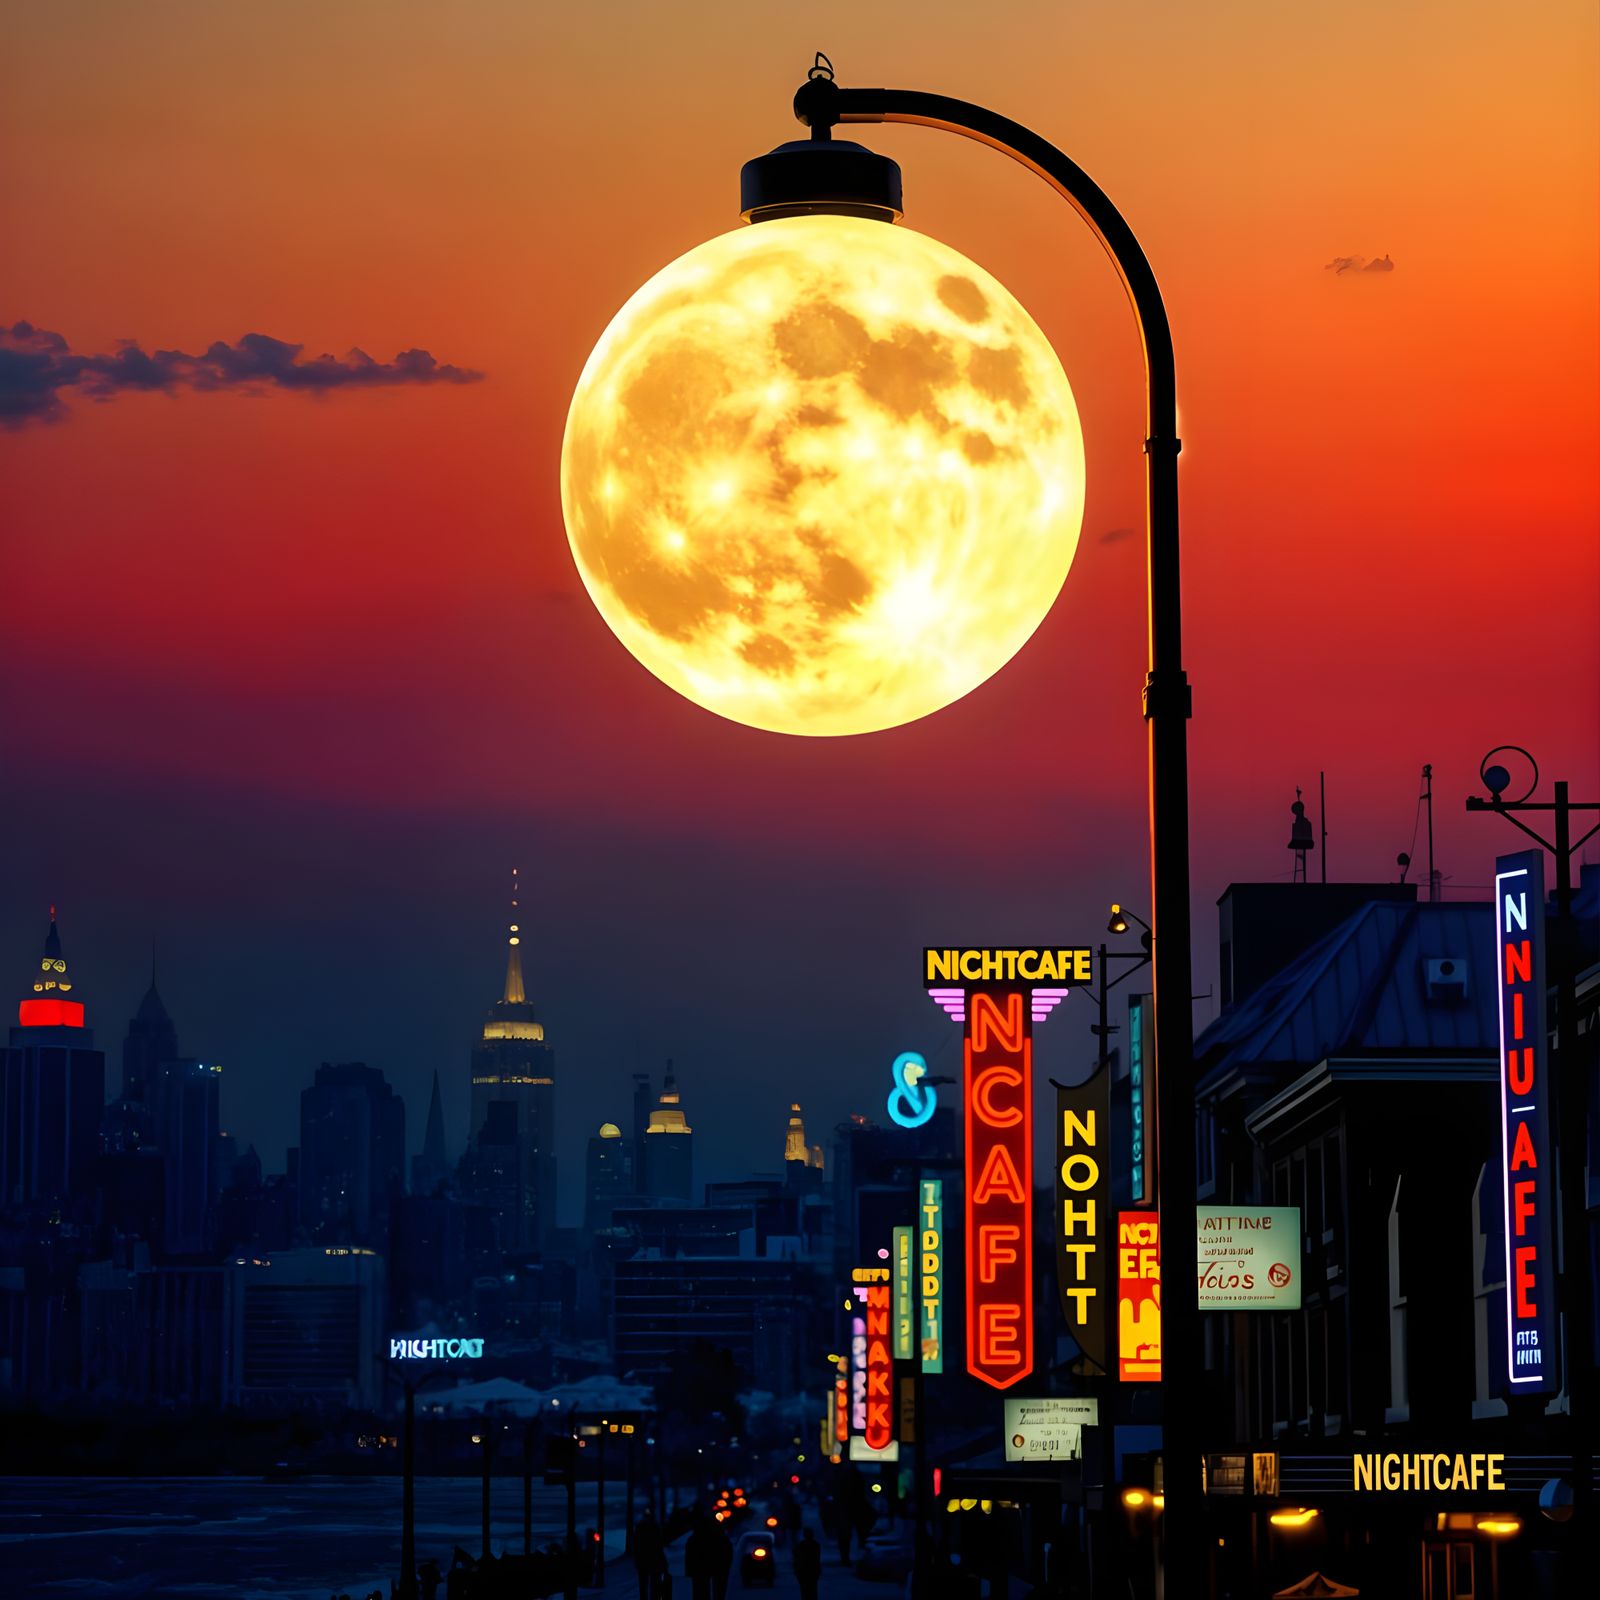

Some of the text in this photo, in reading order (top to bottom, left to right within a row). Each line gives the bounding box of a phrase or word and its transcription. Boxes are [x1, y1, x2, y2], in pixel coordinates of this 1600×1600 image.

[927, 950, 1091, 980] NICHTCAFE
[971, 993, 1025, 1364] NCAFE
[1061, 1110, 1099, 1324] NOHTT
[1353, 1453, 1506, 1491] NIGHTCAFE
